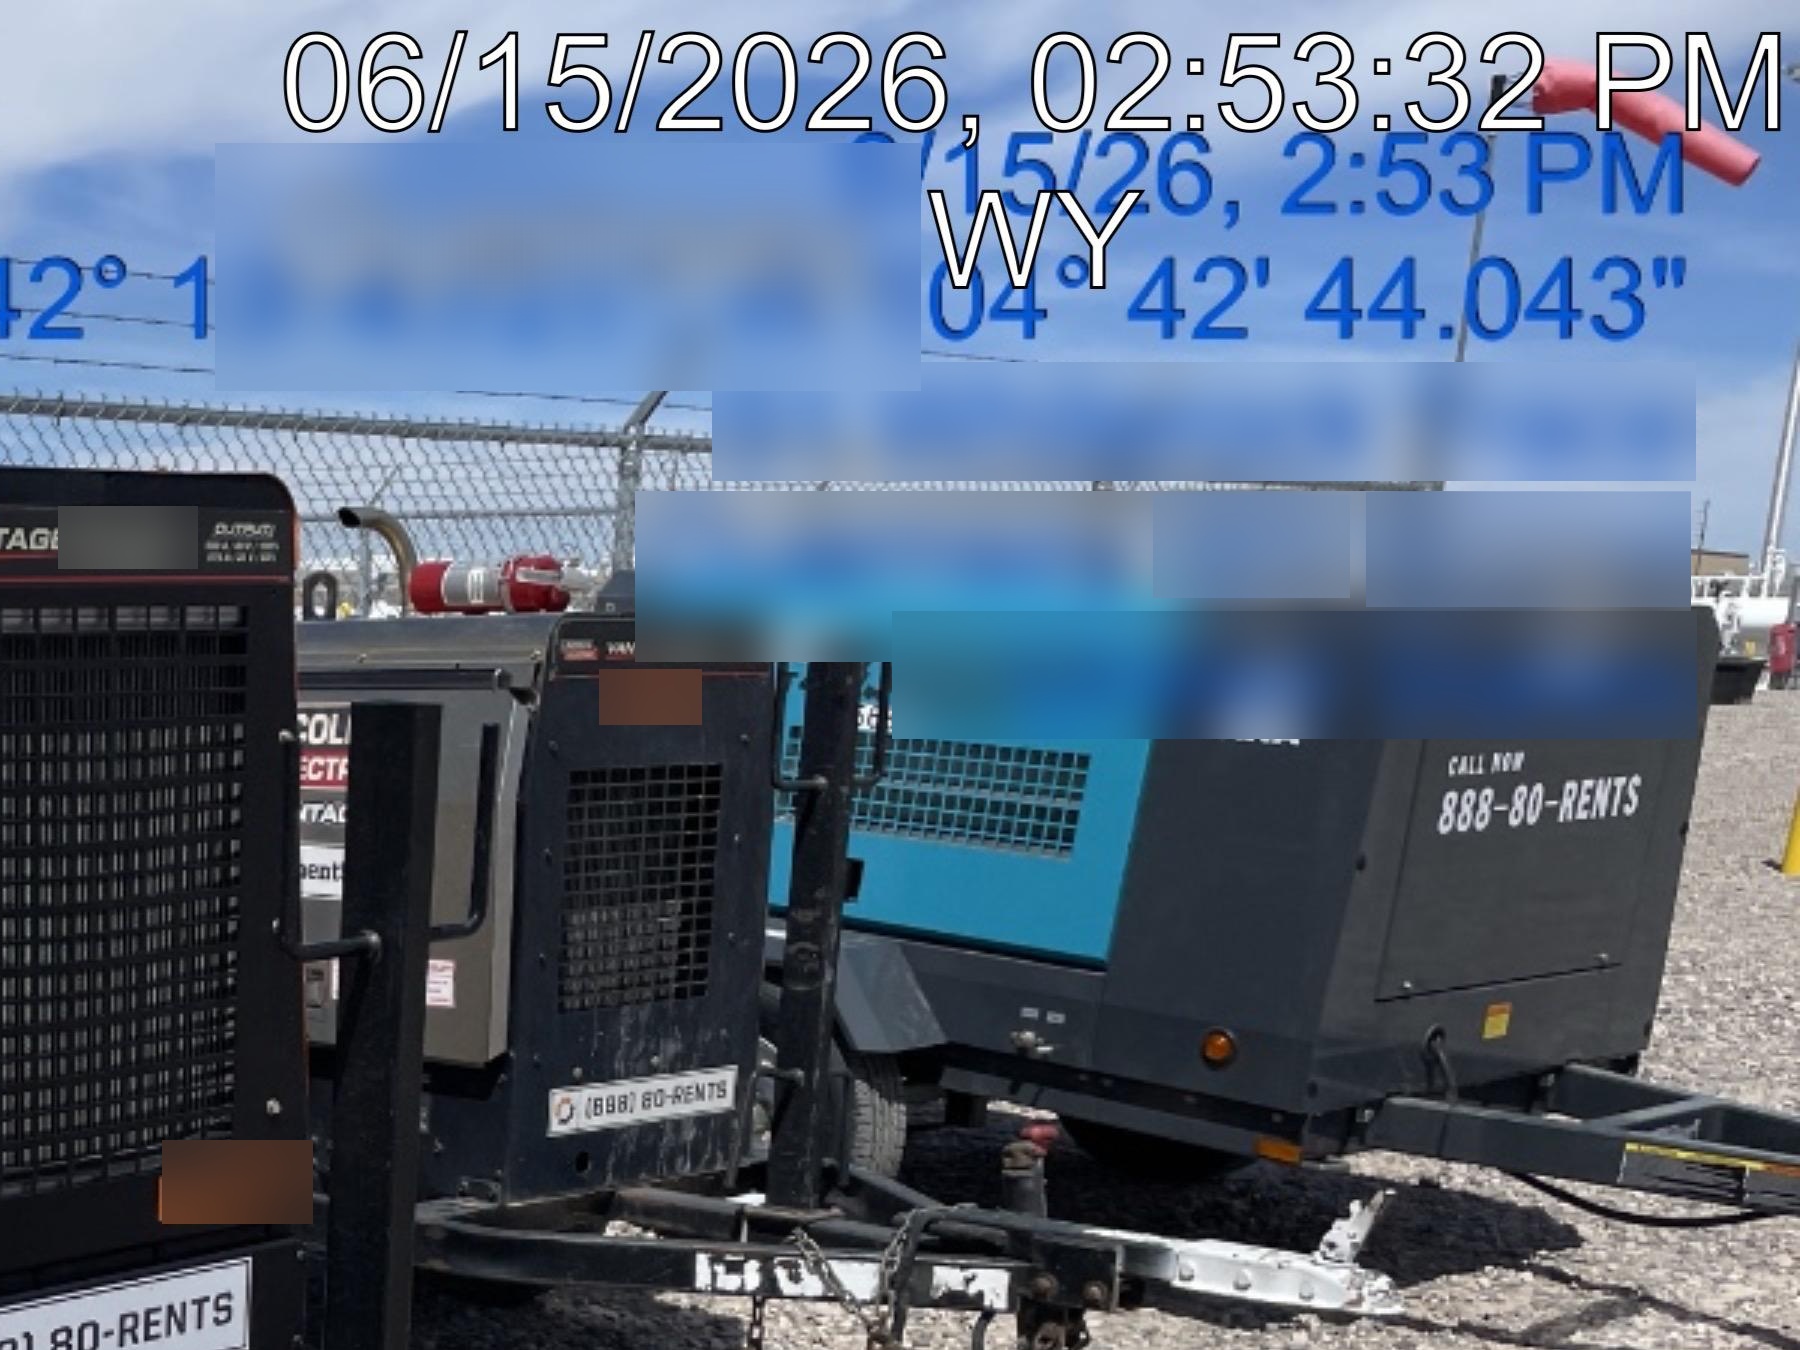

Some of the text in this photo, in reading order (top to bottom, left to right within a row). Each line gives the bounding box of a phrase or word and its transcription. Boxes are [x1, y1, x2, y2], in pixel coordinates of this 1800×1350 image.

[1448, 751, 1525, 777] CALL NOW
[1437, 772, 1643, 835] 888-80-RENTS
